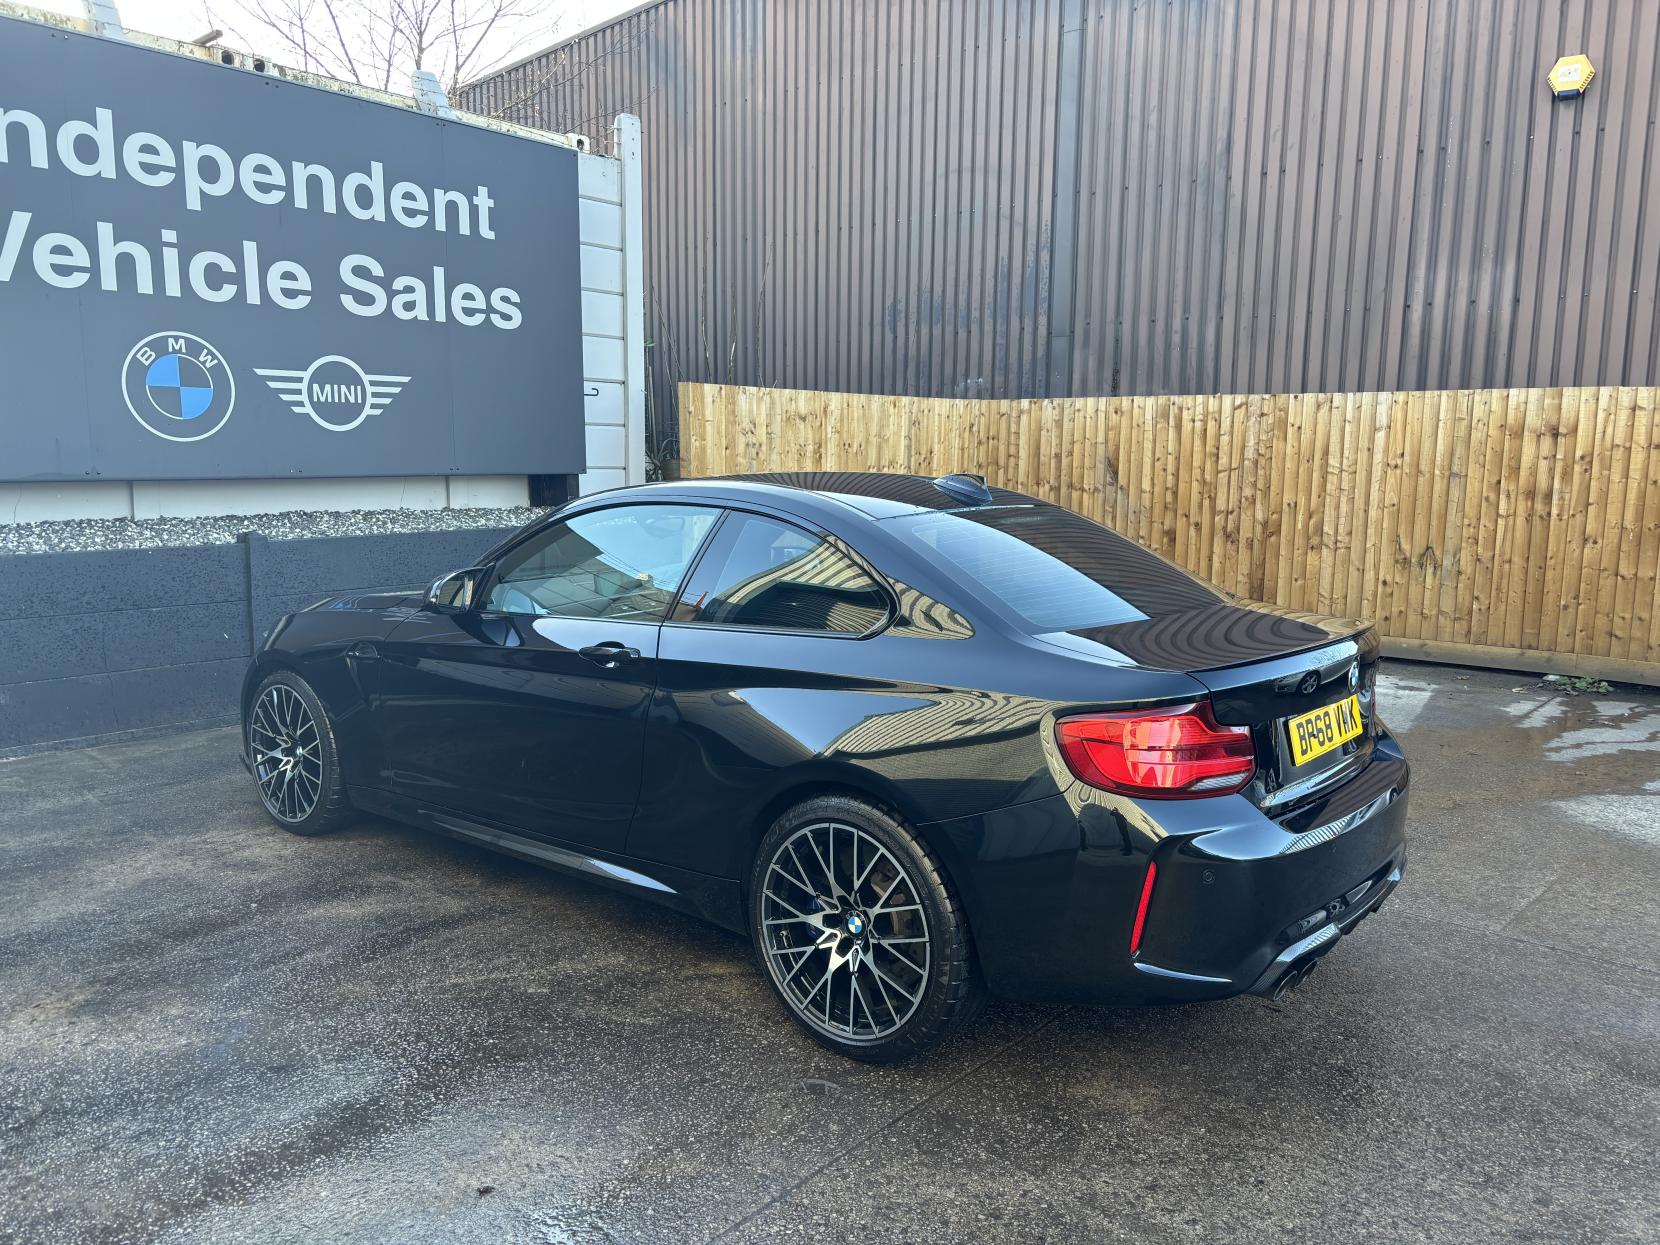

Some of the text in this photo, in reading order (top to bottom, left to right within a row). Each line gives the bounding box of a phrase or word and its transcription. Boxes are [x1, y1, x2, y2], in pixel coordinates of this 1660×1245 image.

[0, 107, 496, 240] ndependent
[340, 254, 523, 330] Sales
[136, 337, 219, 370] BMW
[312, 383, 363, 404] MINI
[1295, 710, 1334, 757] BP68
